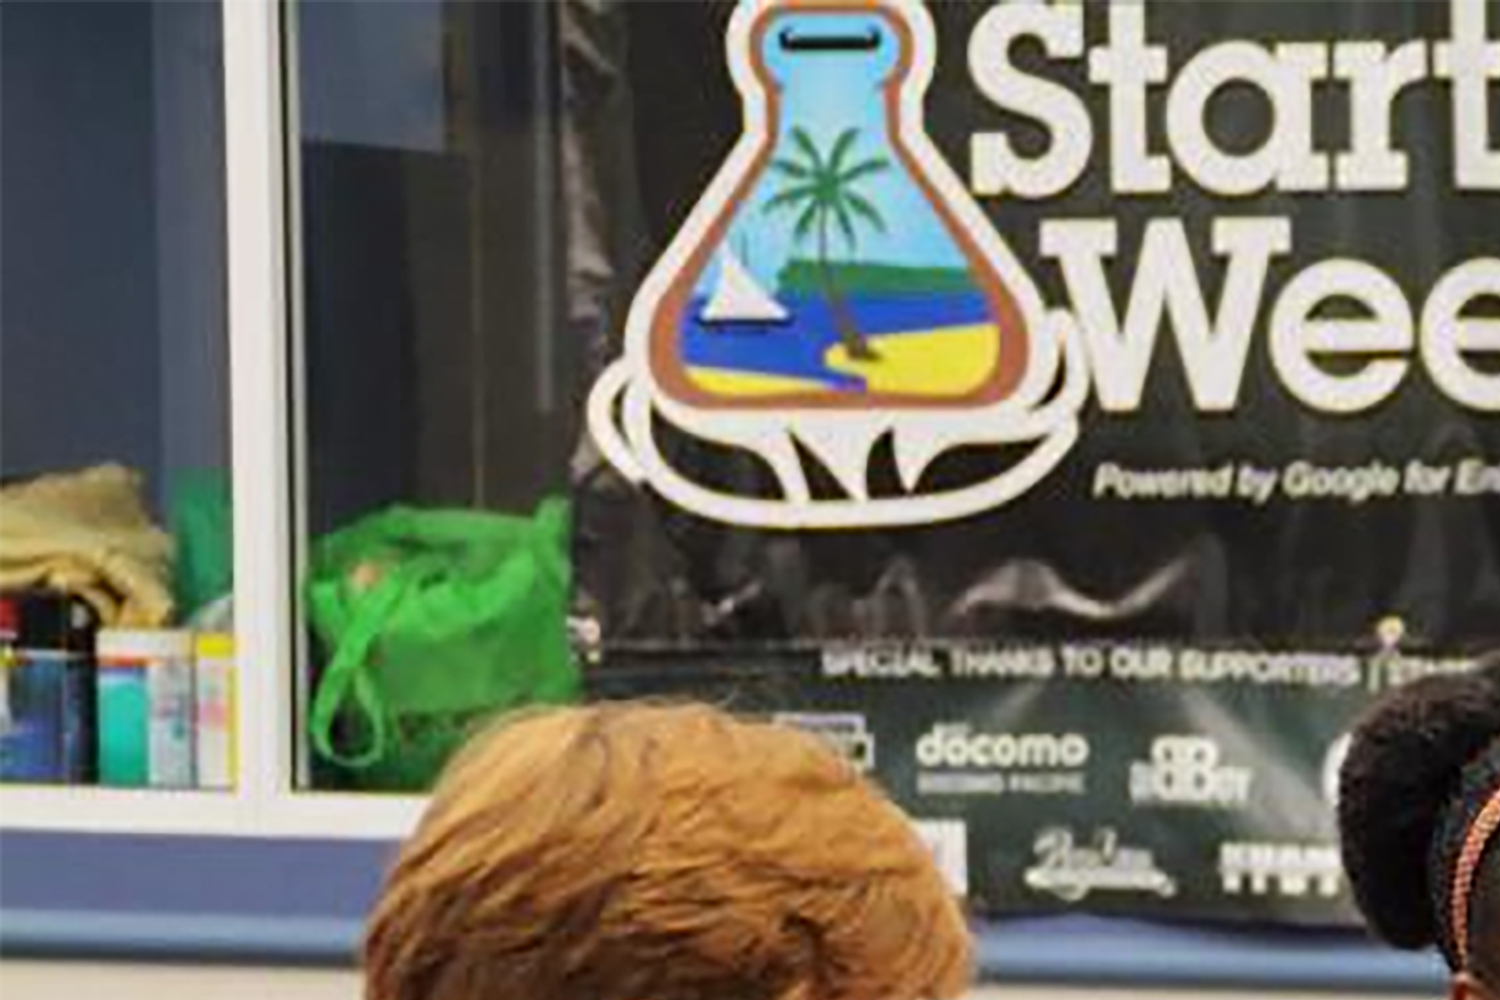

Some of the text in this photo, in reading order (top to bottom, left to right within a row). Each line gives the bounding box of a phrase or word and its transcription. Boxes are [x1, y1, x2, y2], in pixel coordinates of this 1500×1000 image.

[1094, 460, 1234, 499] Powered
[1237, 459, 1277, 505] by
[1283, 459, 1399, 504] Google
[1403, 459, 1450, 494] for
[822, 647, 940, 677] SPECIAL
[951, 646, 1053, 677] THANKS
[1061, 645, 1102, 677] TO
[1110, 647, 1173, 679] OUR
[1179, 650, 1361, 686] SUPPORTERS
[916, 726, 1090, 768] docomo
